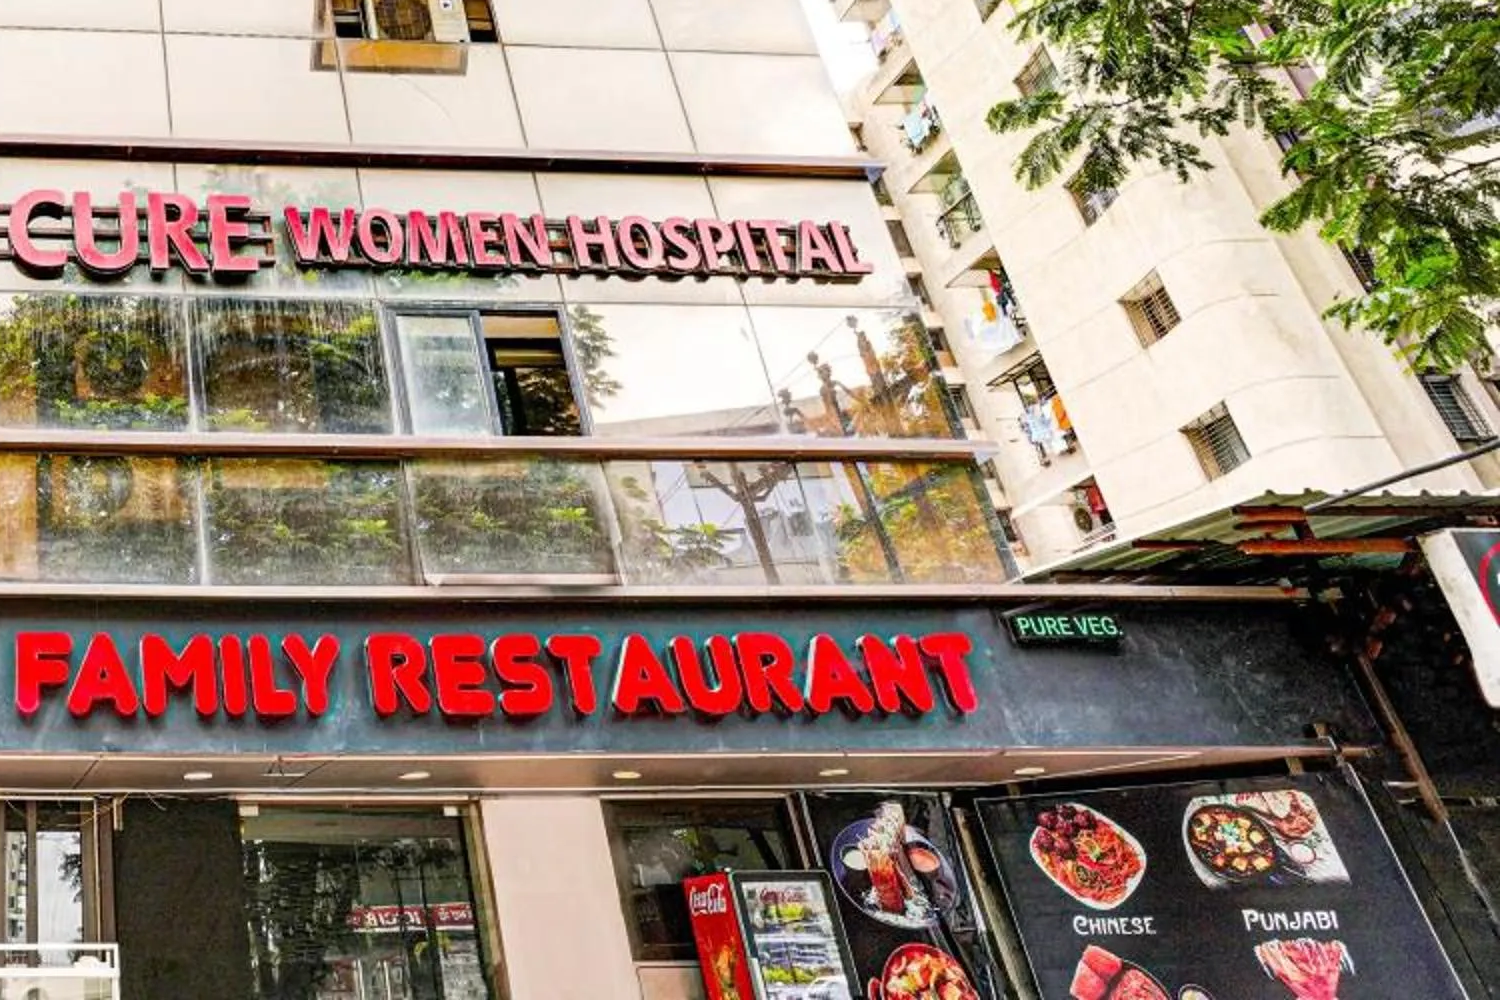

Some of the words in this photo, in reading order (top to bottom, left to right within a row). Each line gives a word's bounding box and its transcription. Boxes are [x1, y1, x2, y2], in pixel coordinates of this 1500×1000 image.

[8, 188, 262, 275] CURE
[284, 206, 552, 270] WOMEN
[568, 215, 874, 278] HOSPITAL
[1016, 614, 1071, 637] PURE
[1073, 615, 1123, 637] VEG.
[14, 632, 340, 718] FAMILY
[363, 632, 978, 720] RESTAURANT
[1072, 915, 1157, 936] CHINESE
[1243, 908, 1339, 932] PUNJABI
